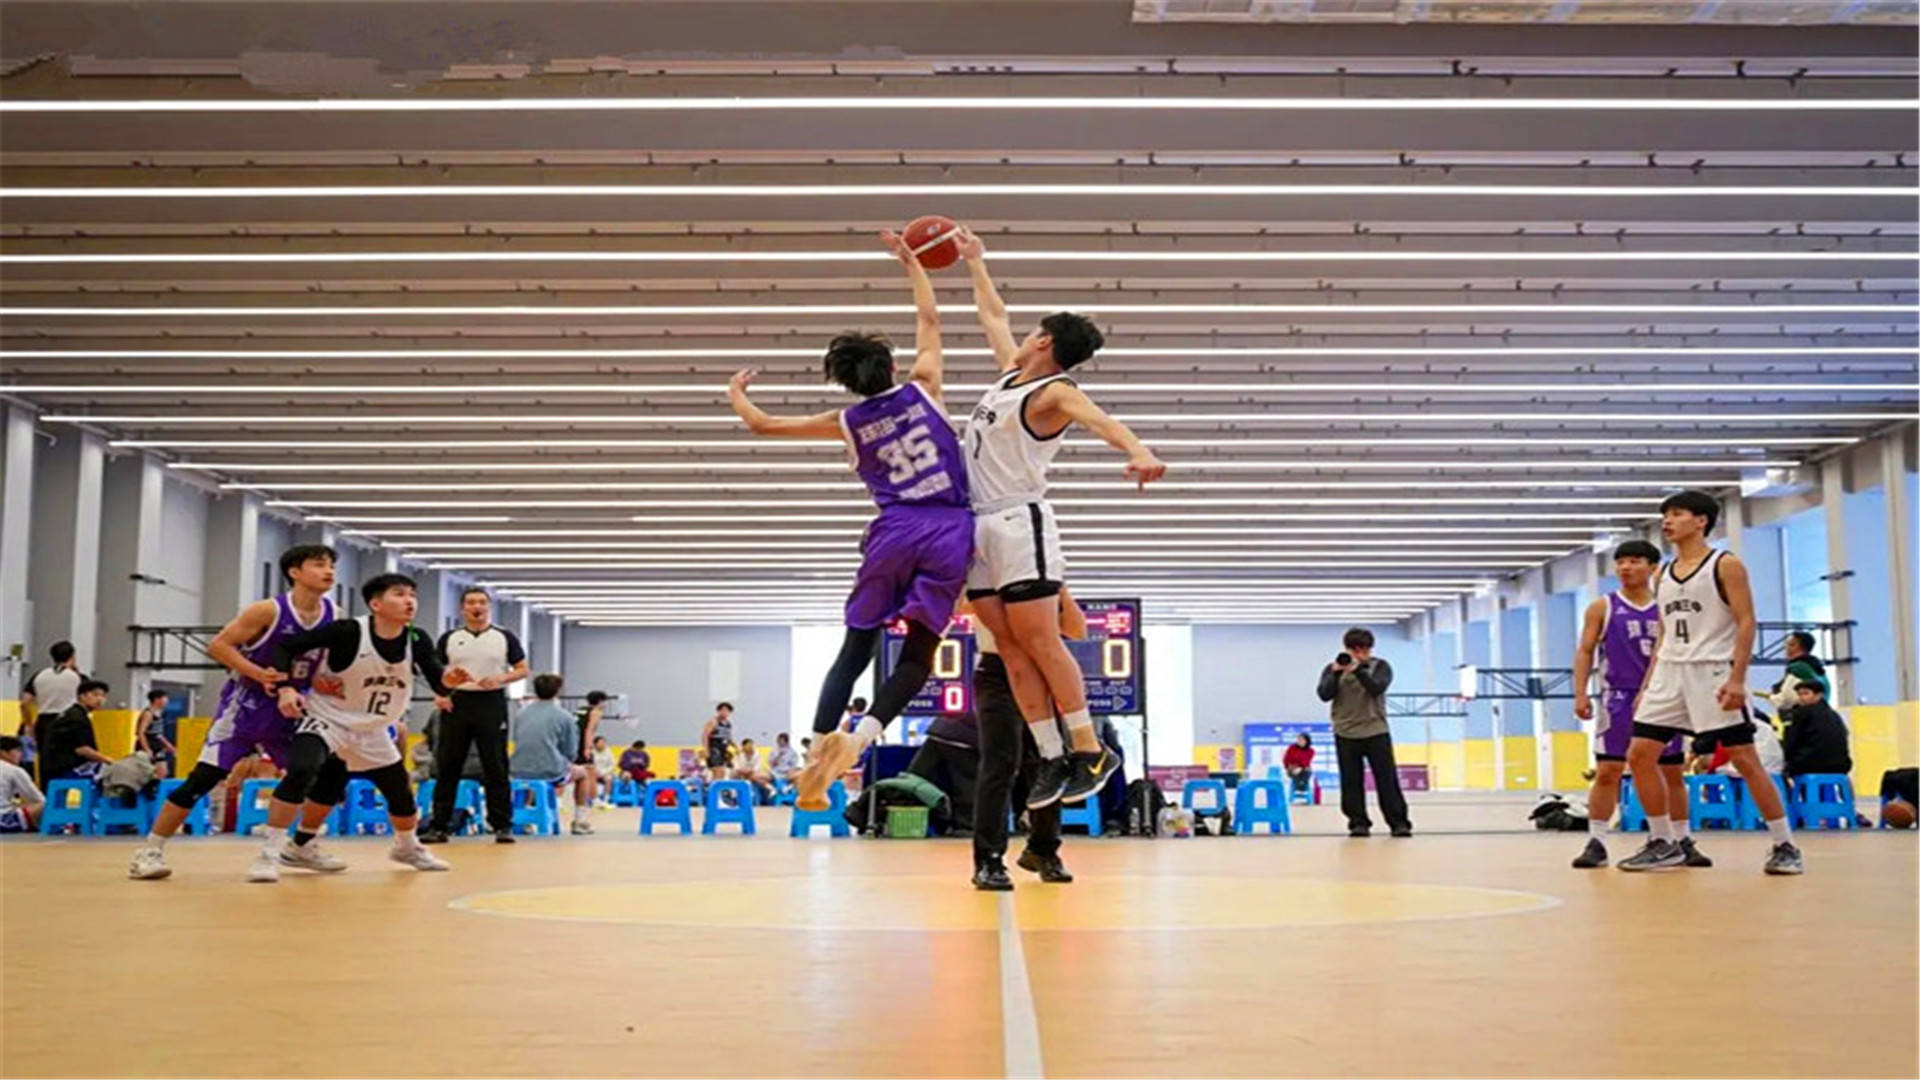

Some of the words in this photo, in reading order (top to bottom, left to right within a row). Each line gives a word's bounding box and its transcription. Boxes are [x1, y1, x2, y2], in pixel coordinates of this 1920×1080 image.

[877, 424, 939, 484] 35
[1675, 619, 1689, 644] 4
[934, 639, 962, 679] 0
[1104, 639, 1131, 678] 0
[366, 691, 391, 716] 12
[945, 687, 963, 710] 0
